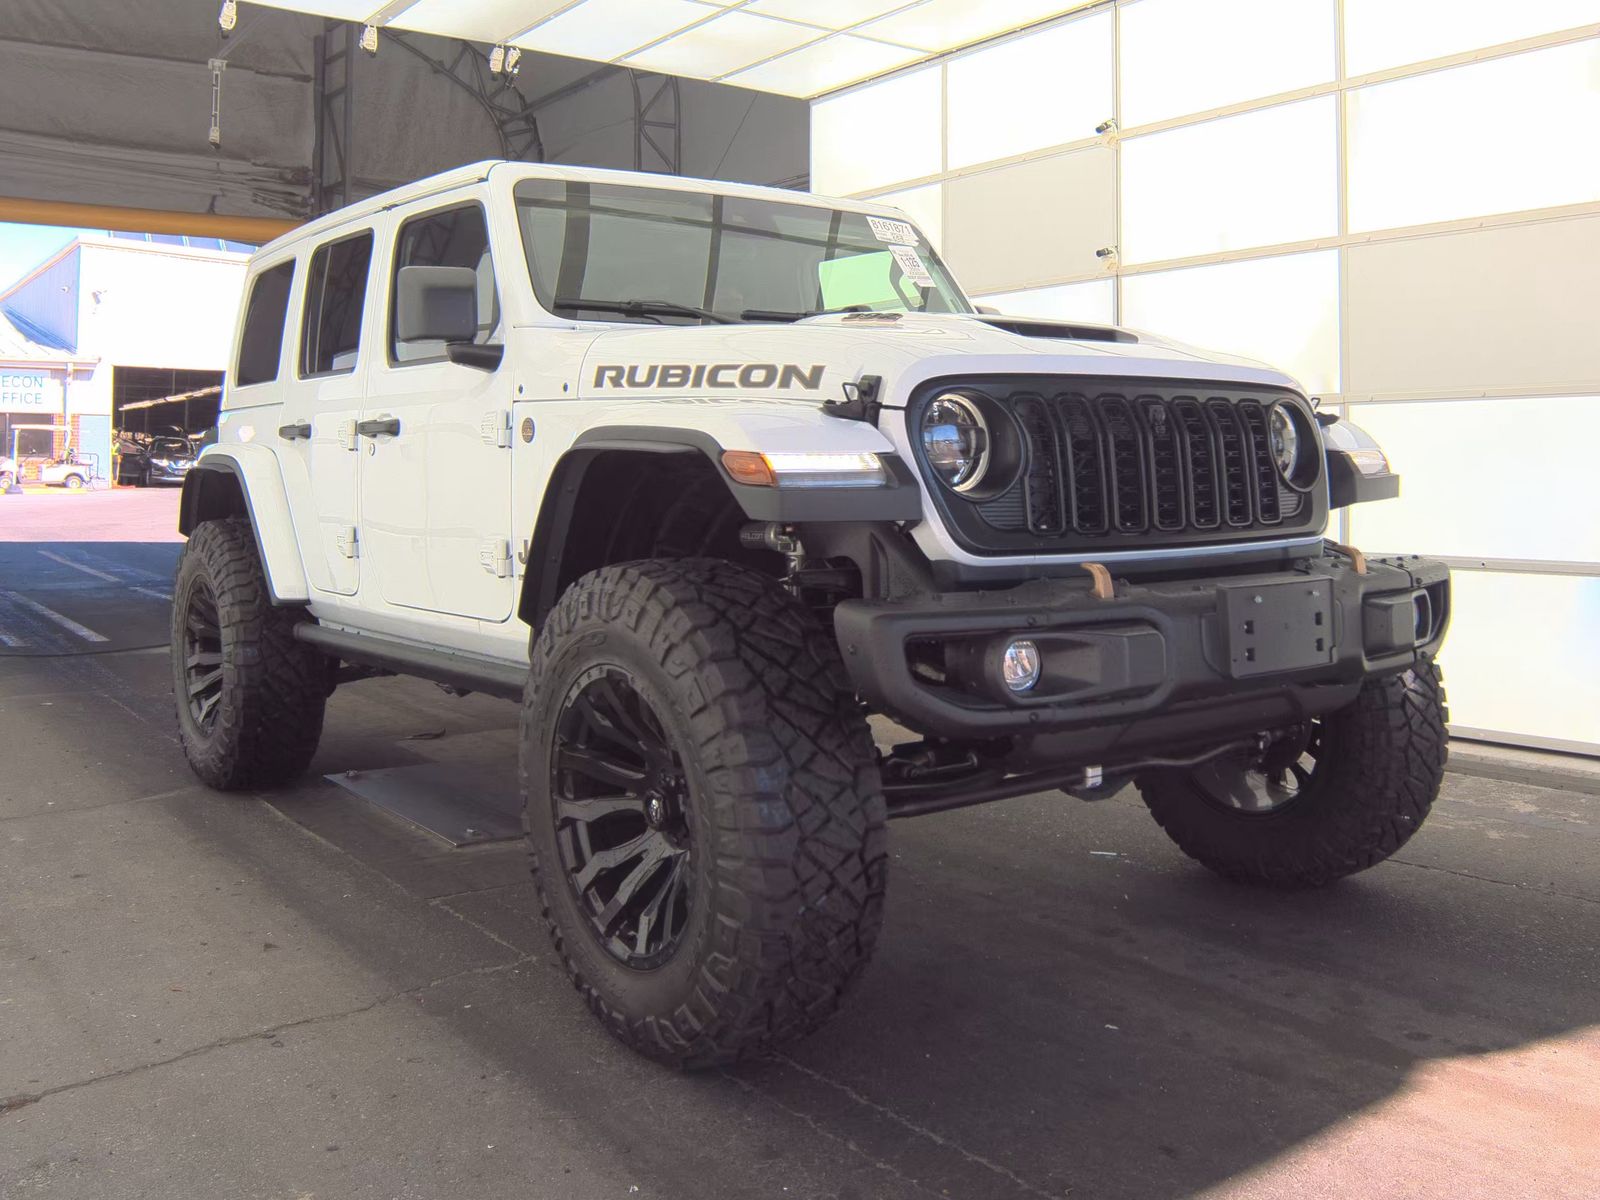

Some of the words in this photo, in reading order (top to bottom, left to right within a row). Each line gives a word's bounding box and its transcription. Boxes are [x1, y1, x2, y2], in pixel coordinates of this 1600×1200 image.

[870, 220, 911, 235] 8161871
[0, 375, 43, 388] ECON
[593, 364, 826, 390] RUBICON
[0, 392, 43, 404] FFICE
